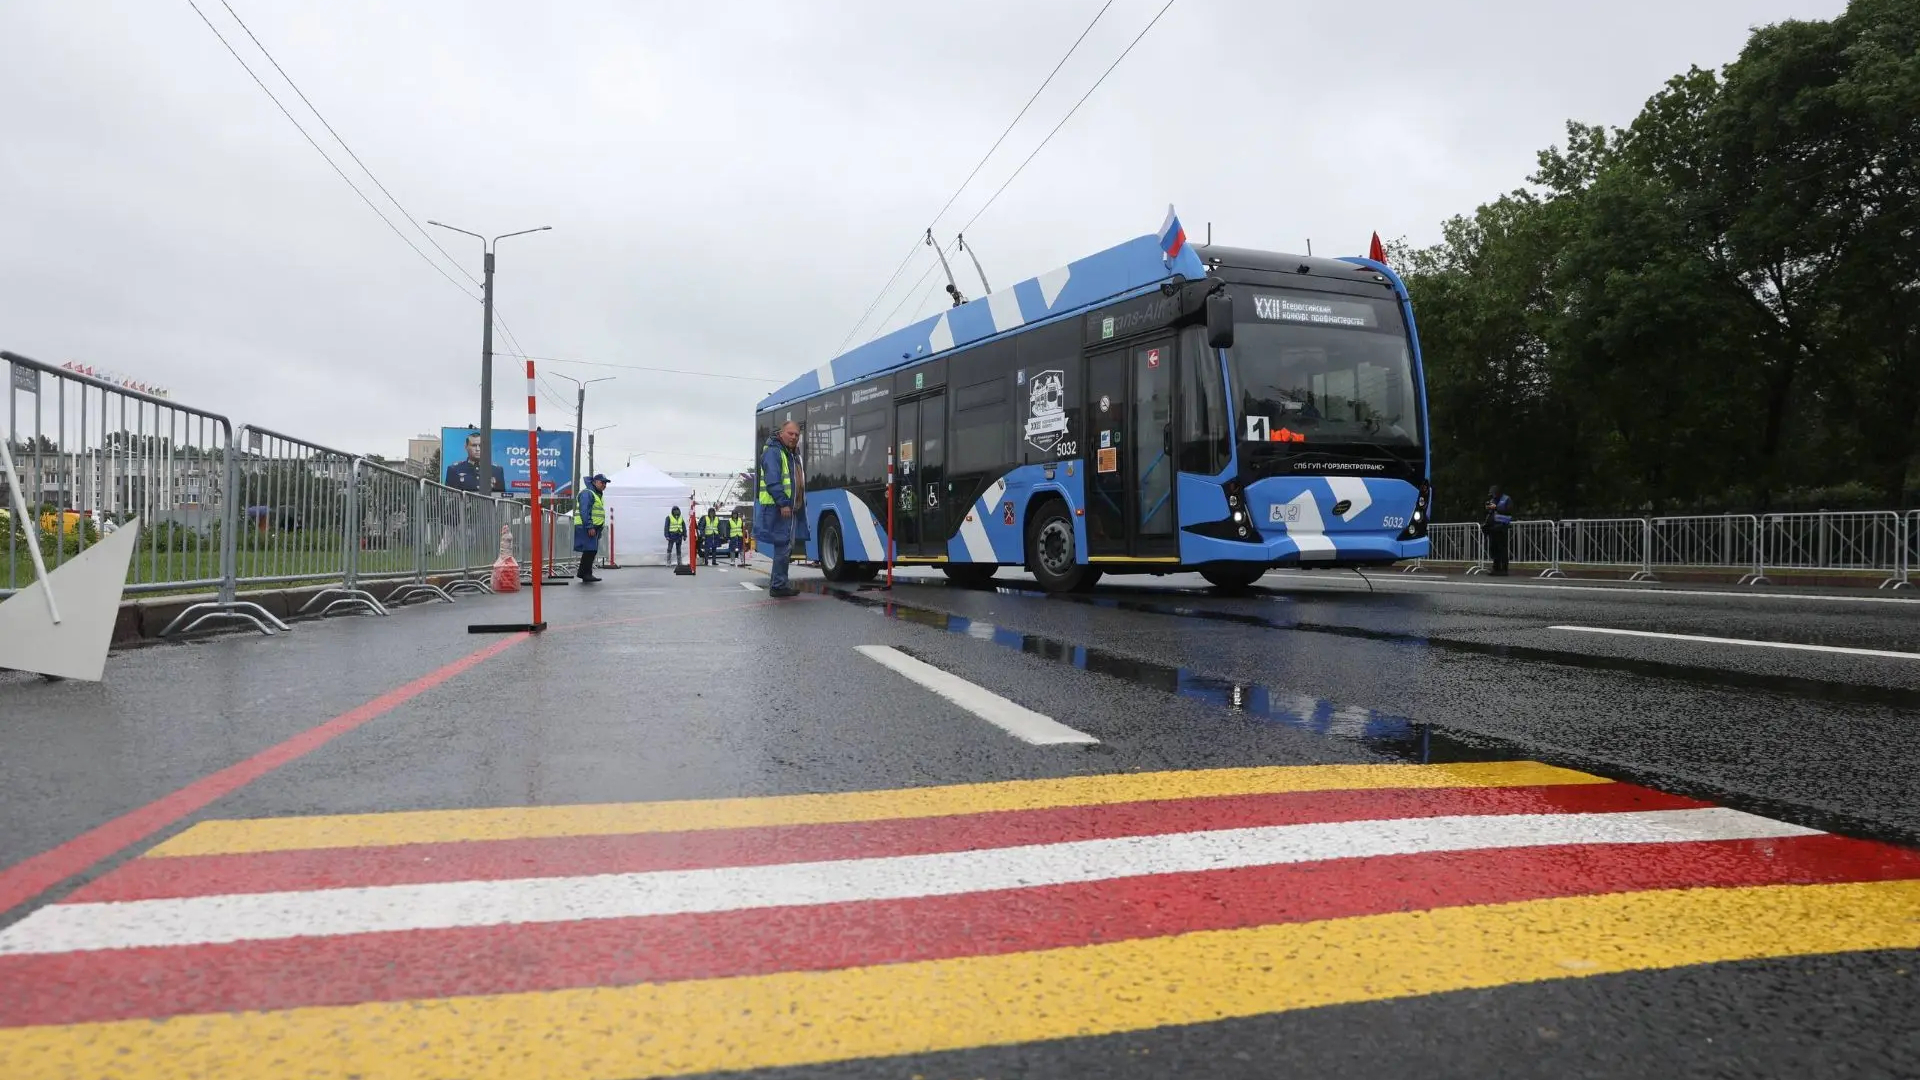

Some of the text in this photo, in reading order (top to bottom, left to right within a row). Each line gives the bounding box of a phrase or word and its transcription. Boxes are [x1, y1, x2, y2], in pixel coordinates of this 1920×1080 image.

[1254, 297, 1280, 320] XXII
[1252, 417, 1265, 441] 1
[1056, 441, 1077, 457] 5032
[510, 458, 557, 467] РОСИИ!
[1383, 516, 1404, 528] 5032
